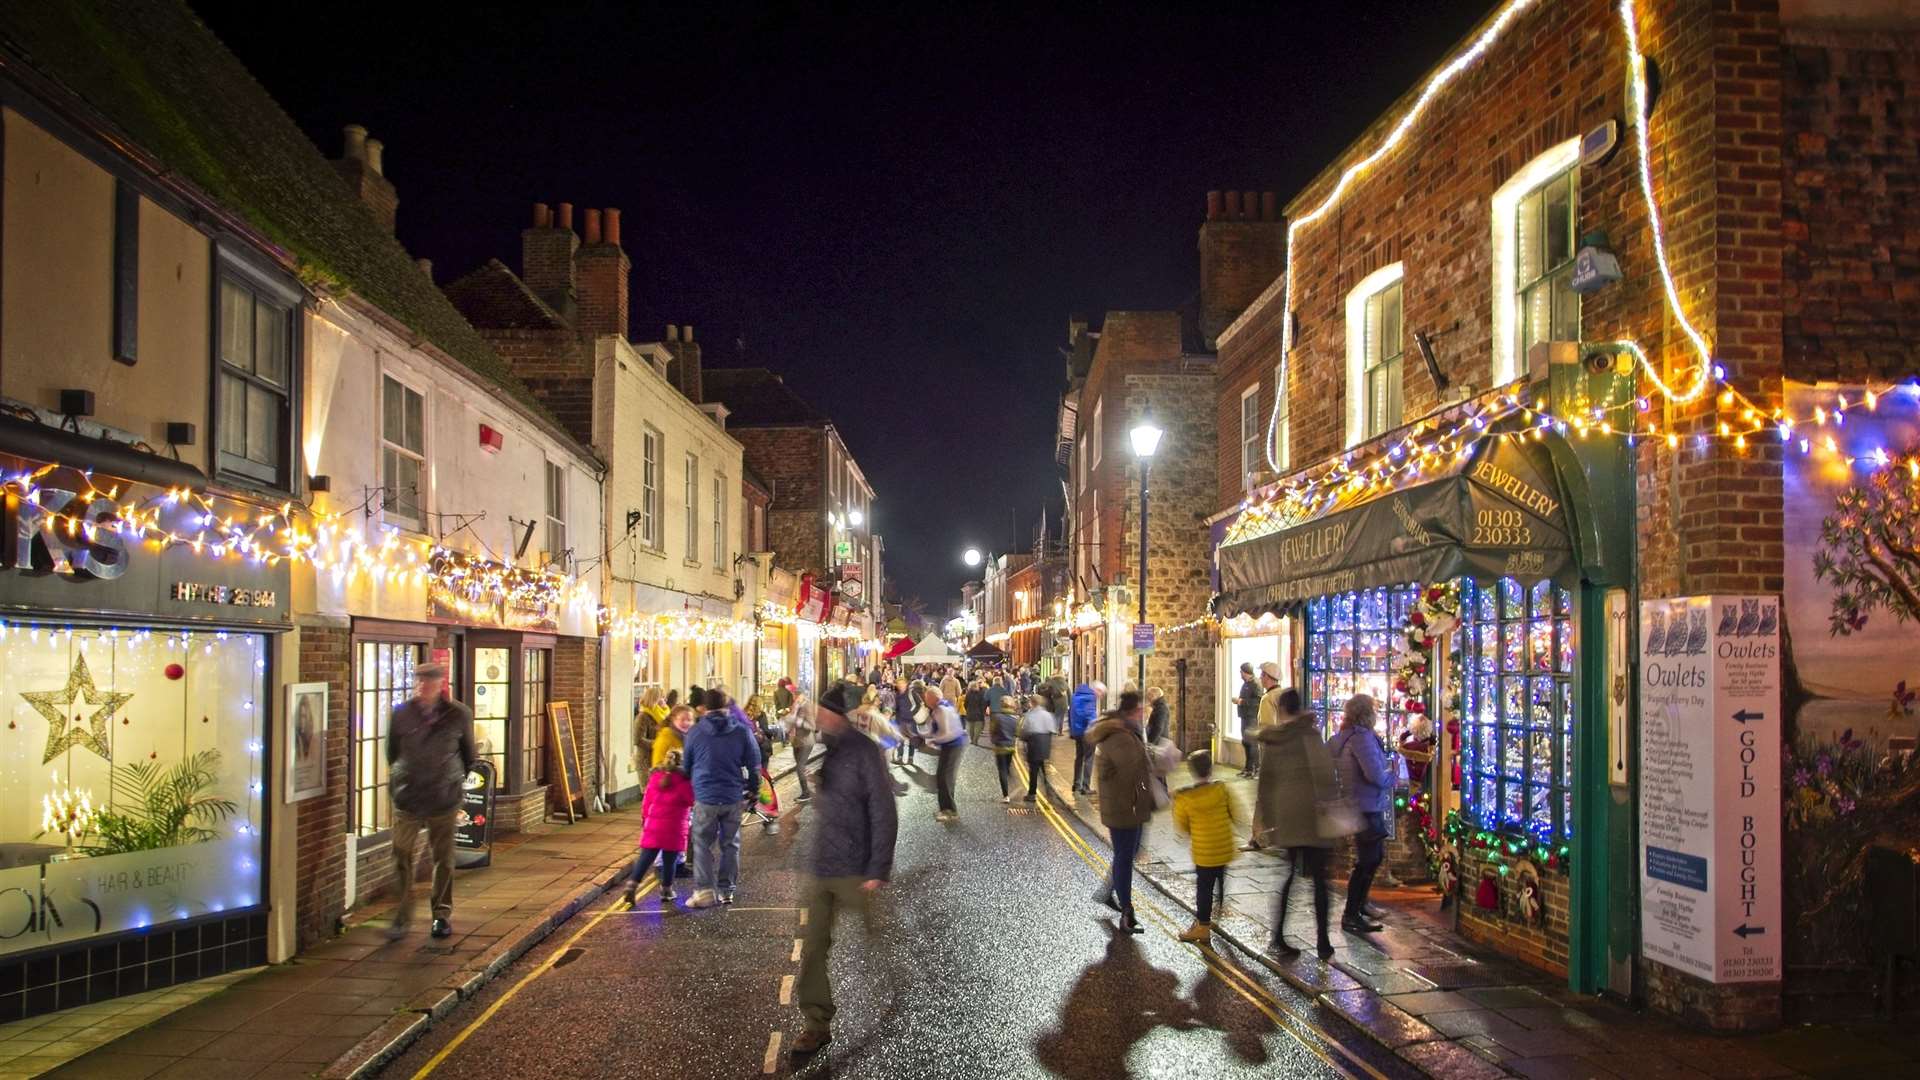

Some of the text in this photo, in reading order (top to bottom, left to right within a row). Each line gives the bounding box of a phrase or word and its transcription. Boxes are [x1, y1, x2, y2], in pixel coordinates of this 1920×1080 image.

[1471, 460, 1559, 517] JEWELLERY
[1477, 509, 1523, 527] 01303
[1280, 521, 1350, 571] JEWELLERY
[1472, 527, 1531, 545] 230333
[177, 582, 228, 604] HYTHE
[1265, 576, 1312, 604] OWLETS
[1717, 640, 1776, 660] Owlets
[1646, 661, 1706, 688] Owlets
[1691, 695, 1705, 709] Day
[1740, 730, 1756, 918] GOLD BOUGHT
[97, 871, 129, 894] HAIR
[133, 869, 144, 889] &
